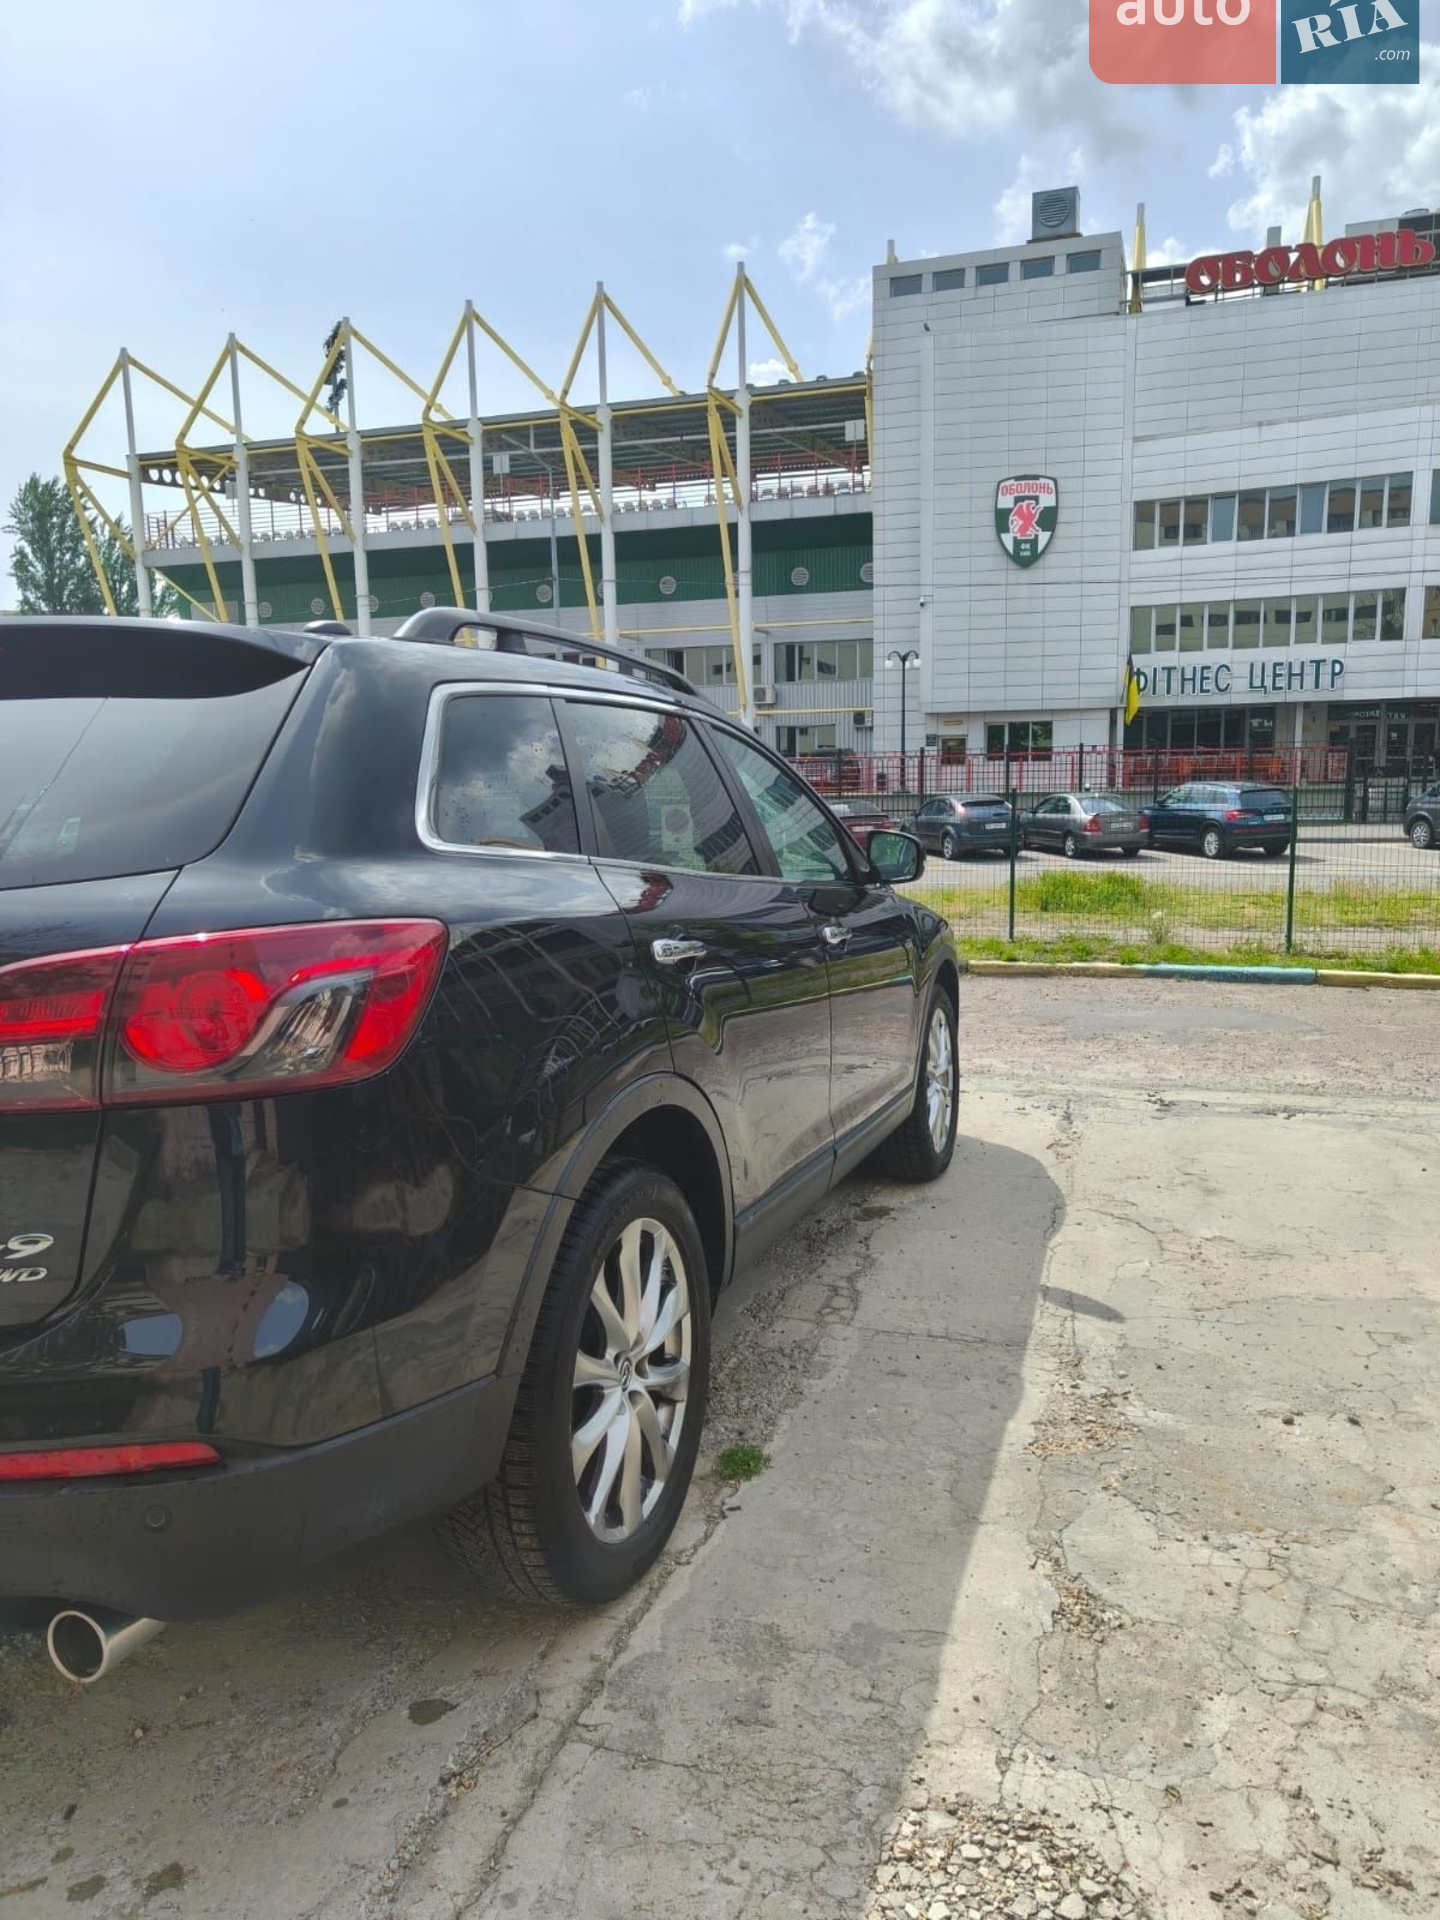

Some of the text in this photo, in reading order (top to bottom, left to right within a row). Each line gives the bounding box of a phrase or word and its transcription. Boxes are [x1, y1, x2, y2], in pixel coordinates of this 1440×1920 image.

[1185, 228, 1436, 294] ОБОЛОНЬ
[1001, 481, 1053, 496] ОБОЛОНЬ
[1248, 658, 1345, 695] ЦЕНТР
